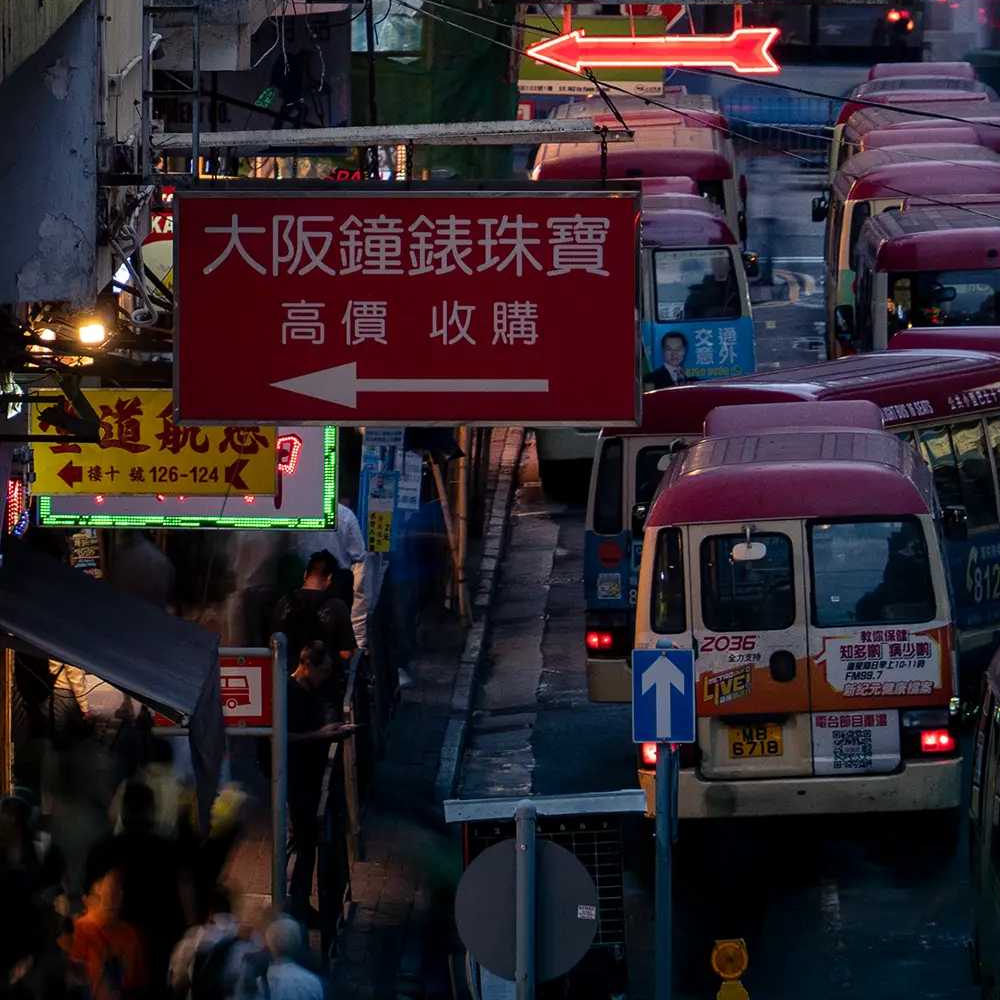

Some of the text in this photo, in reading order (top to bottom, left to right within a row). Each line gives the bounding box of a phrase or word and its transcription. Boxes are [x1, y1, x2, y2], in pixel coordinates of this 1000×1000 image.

[203, 213, 610, 277] 大阪鐘錶珠寶
[281, 300, 539, 346] 高價 收購
[694, 326, 737, 347] 交通
[695, 344, 738, 365] 意外
[701, 635, 756, 652] 2036
[860, 629, 909, 642] 教你保健
[728, 652, 762, 663] 全力支持
[844, 670, 882, 681] FM99.7
[703, 672, 752, 707] LIVE!
[815, 713, 888, 729] 電台節目重溫
[742, 727, 768, 741] MB
[732, 741, 779, 757] 6718
